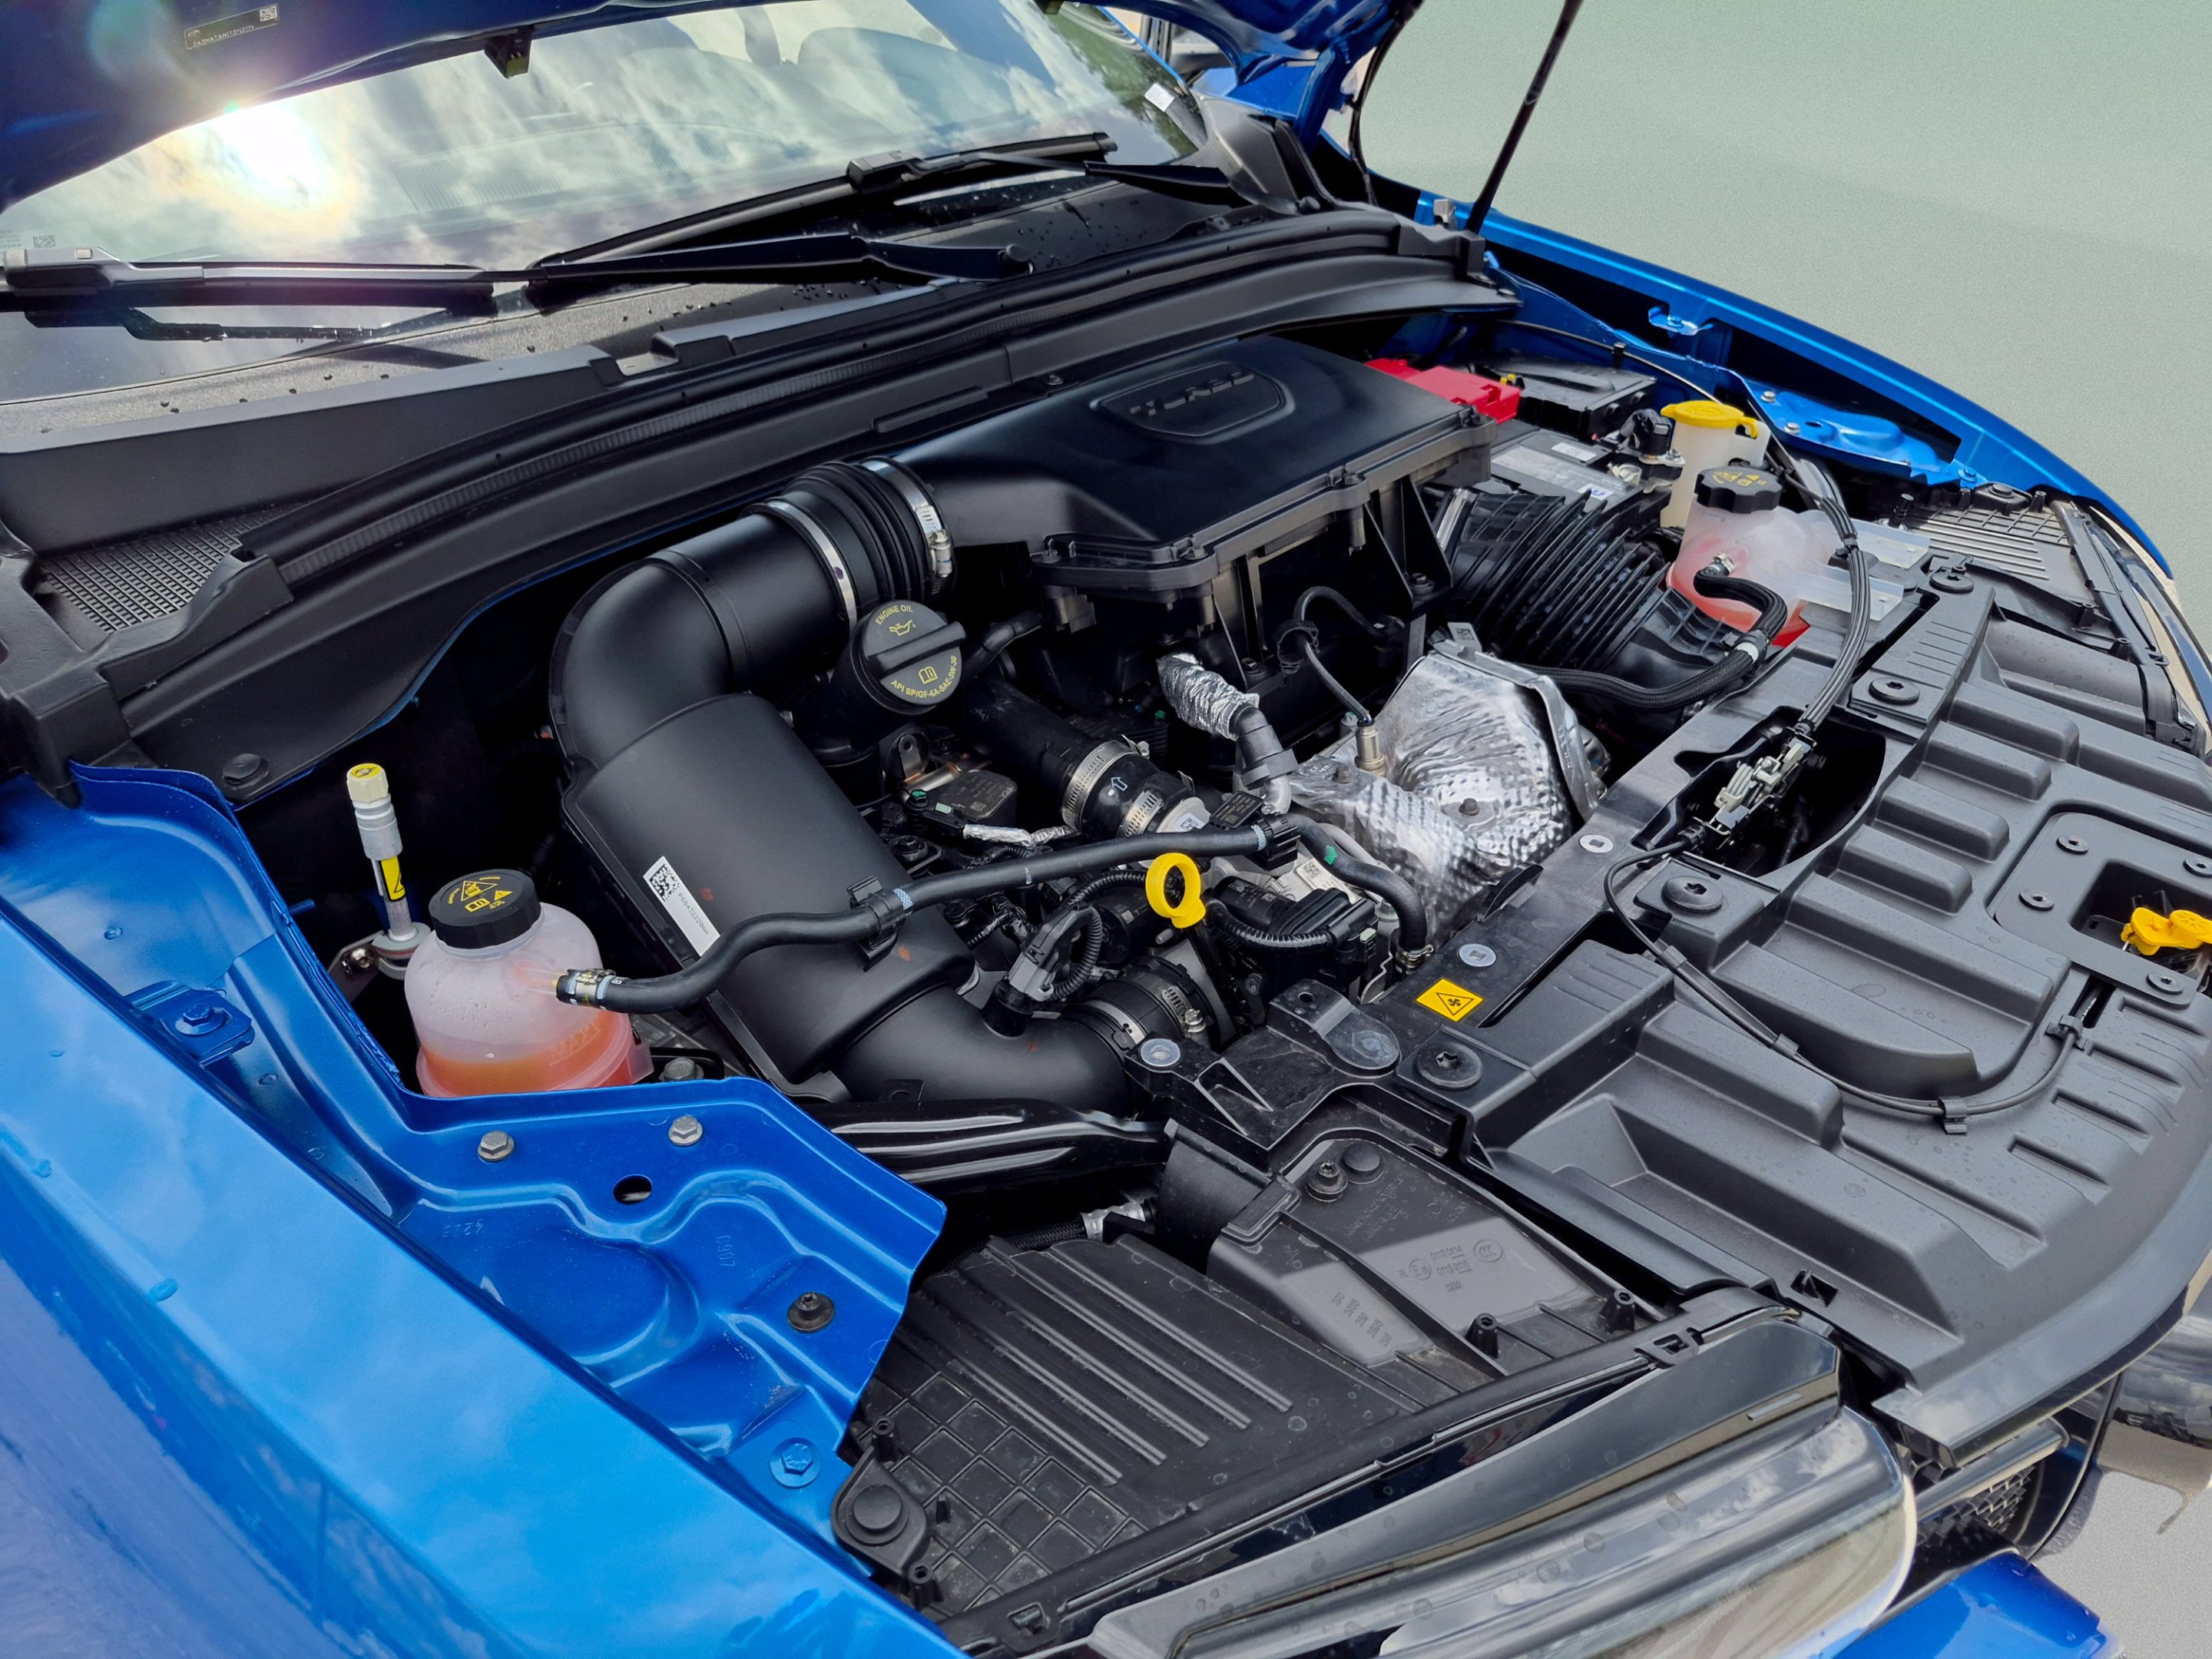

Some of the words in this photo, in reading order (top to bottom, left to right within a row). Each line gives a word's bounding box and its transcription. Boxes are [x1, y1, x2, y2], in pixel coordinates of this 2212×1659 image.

[875, 605, 899, 625] ENGINE
[900, 604, 914, 613] OIL
[891, 680, 905, 692] API
